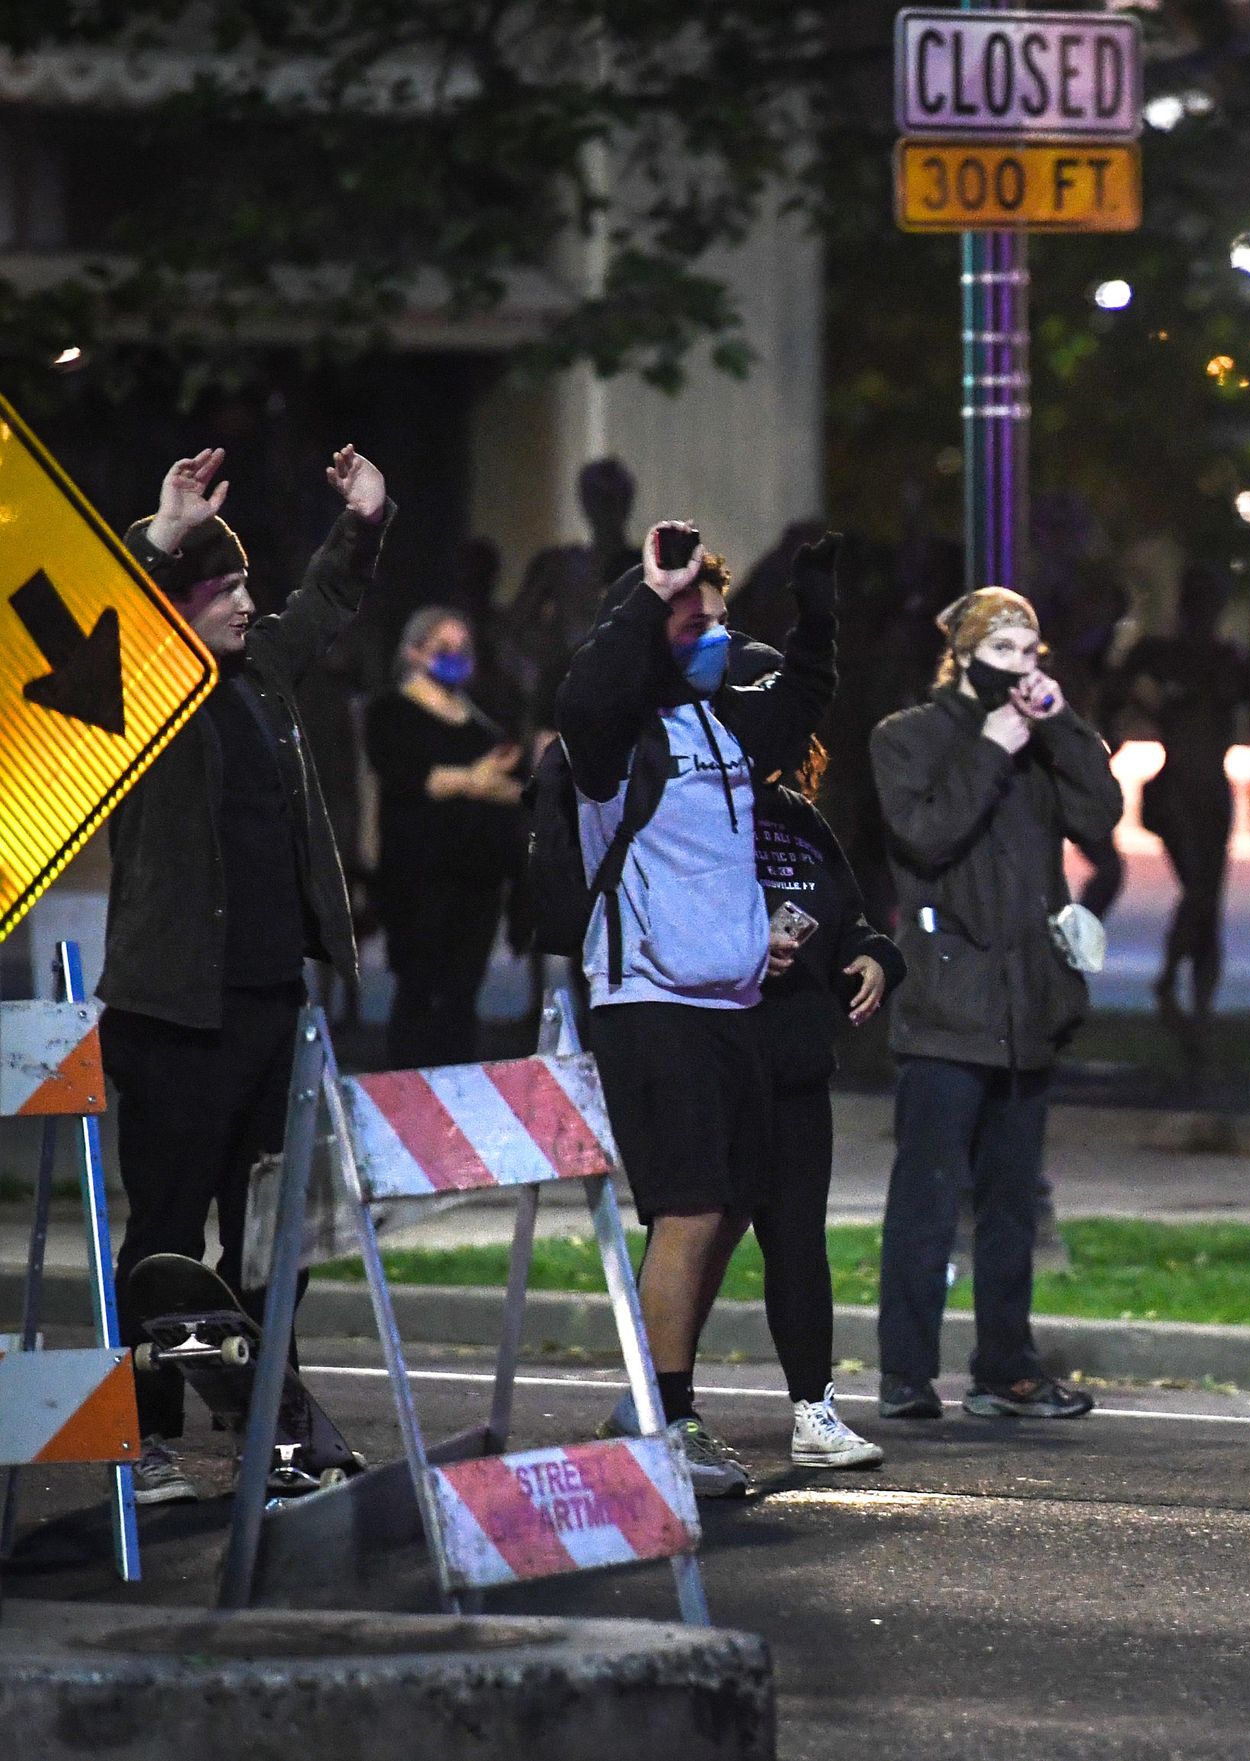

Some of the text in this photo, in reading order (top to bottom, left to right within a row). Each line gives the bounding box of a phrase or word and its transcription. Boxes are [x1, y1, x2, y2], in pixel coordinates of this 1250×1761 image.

[917, 28, 1123, 118] CLOSED
[921, 156, 1111, 210] 300 FT
